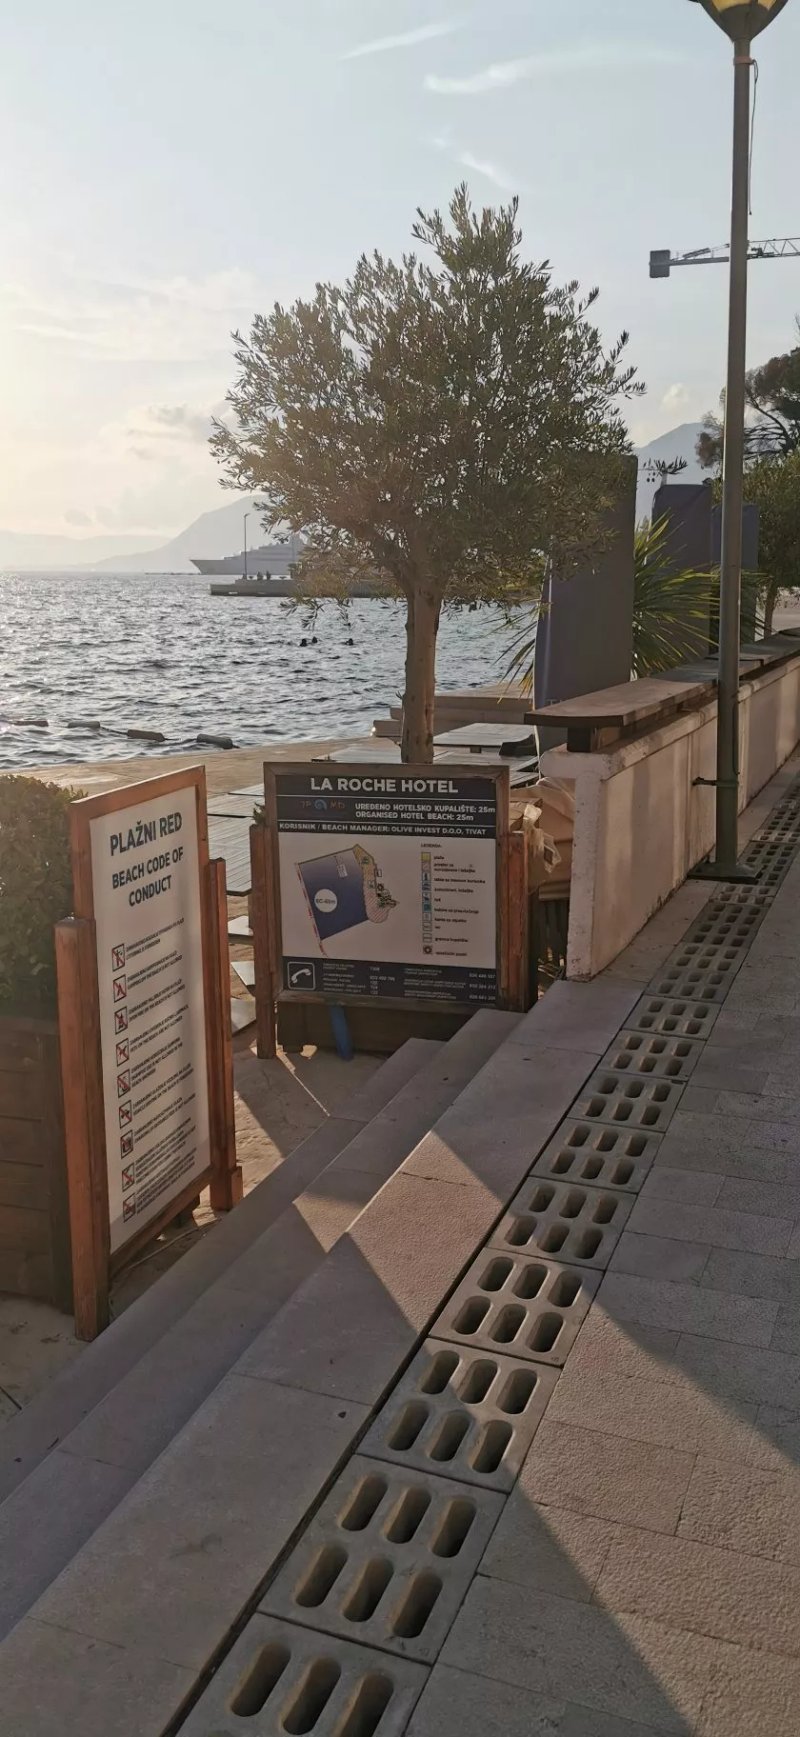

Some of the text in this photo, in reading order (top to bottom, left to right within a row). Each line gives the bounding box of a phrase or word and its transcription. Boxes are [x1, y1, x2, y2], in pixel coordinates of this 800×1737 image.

[310, 777, 459, 793] LA ROCHE HOTEL
[355, 811, 398, 819] ORGANISED
[401, 812, 424, 820] HOTEL
[393, 804, 432, 812] HOTELSKO
[110, 812, 183, 857] PLAŽNI RED
[112, 846, 184, 889] BEACH CODE OF
[128, 875, 172, 907] CONDUCT
